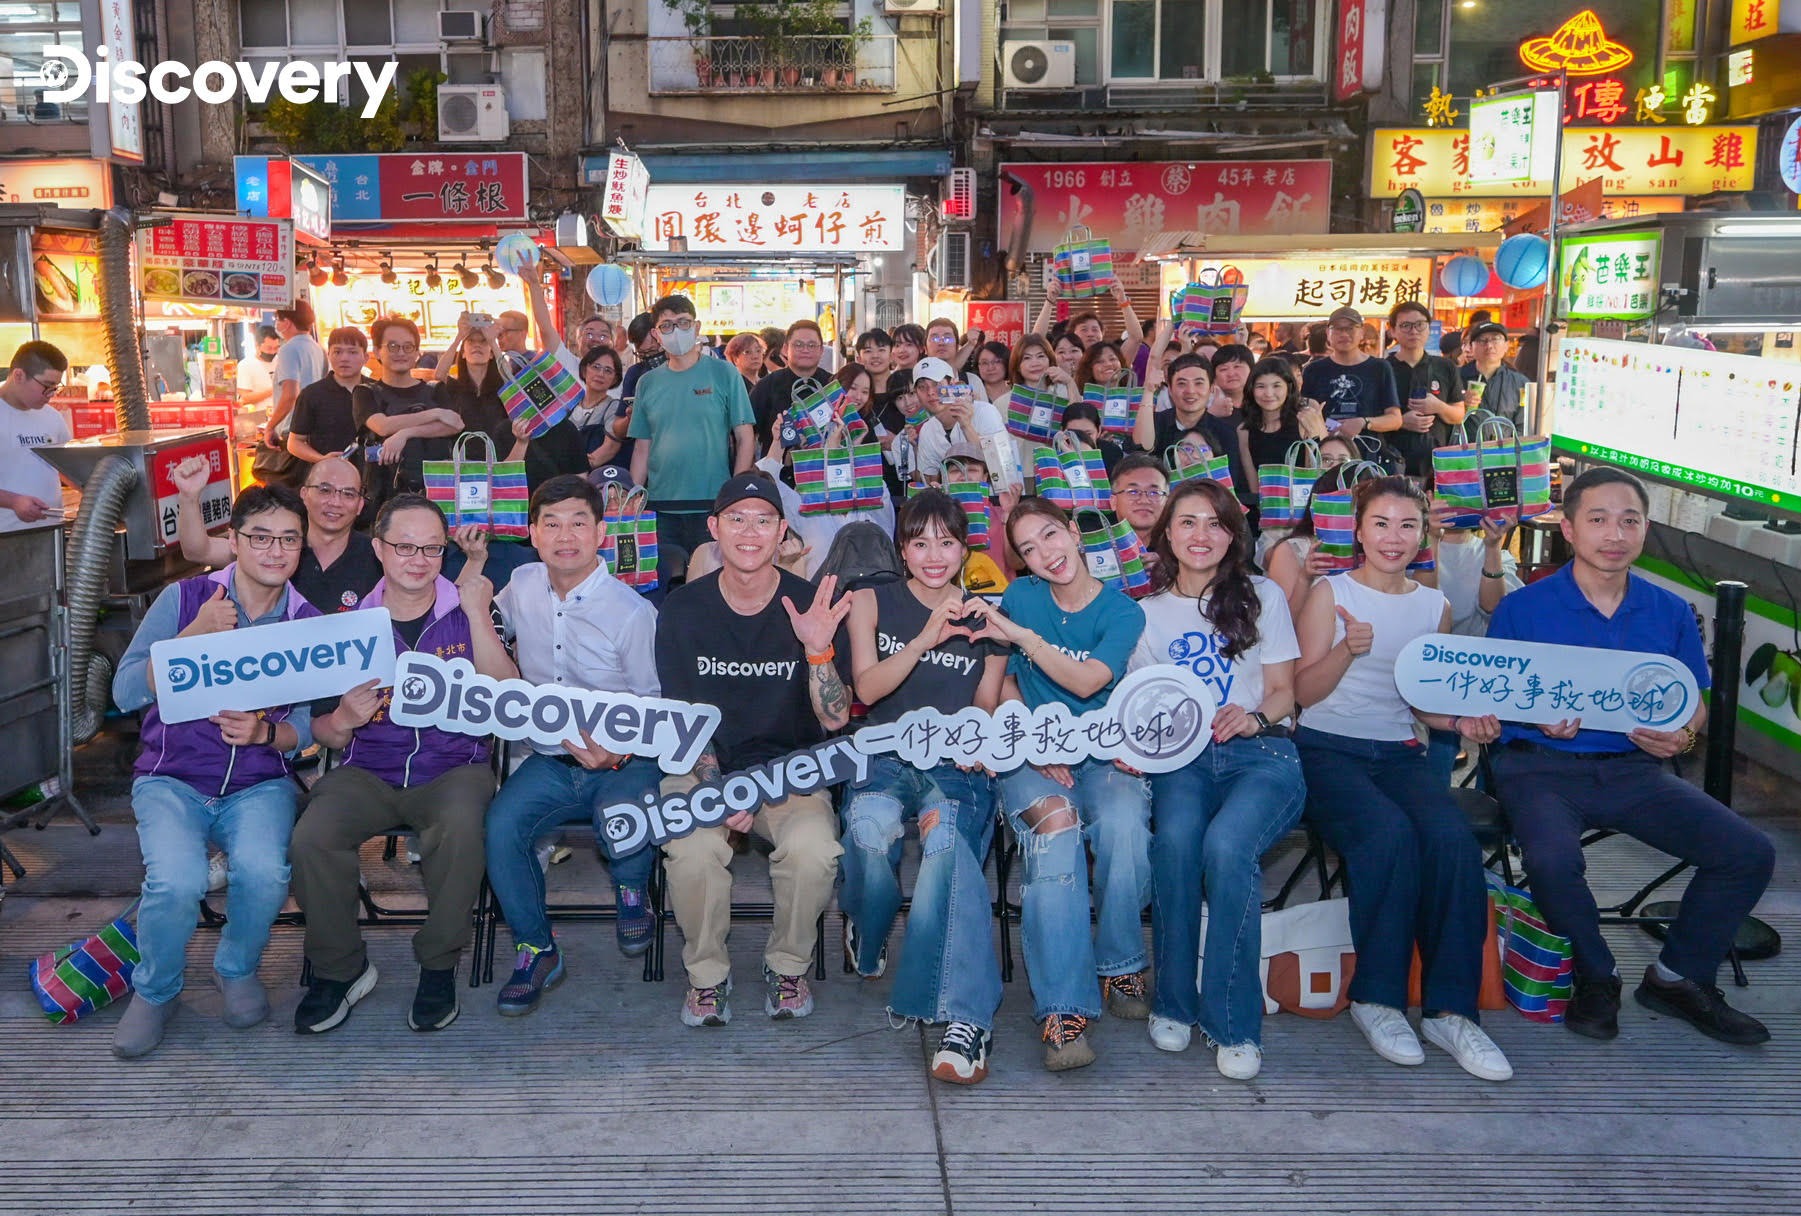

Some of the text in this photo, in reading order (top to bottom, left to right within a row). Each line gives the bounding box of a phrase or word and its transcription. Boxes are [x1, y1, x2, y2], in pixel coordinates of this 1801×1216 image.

[1634, 83, 1716, 126] 便當
[1044, 170, 1085, 187] 1966
[402, 181, 509, 214] 一條根
[693, 191, 852, 208] 台北 老店
[1294, 276, 1424, 308] 起司烤餅
[168, 636, 378, 692] Discovery
[698, 656, 796, 680] Discovery
[877, 632, 978, 676] Disovery
[1422, 643, 1532, 674] Discovery
[402, 662, 710, 763] Discovery
[603, 740, 871, 854] Discovery
